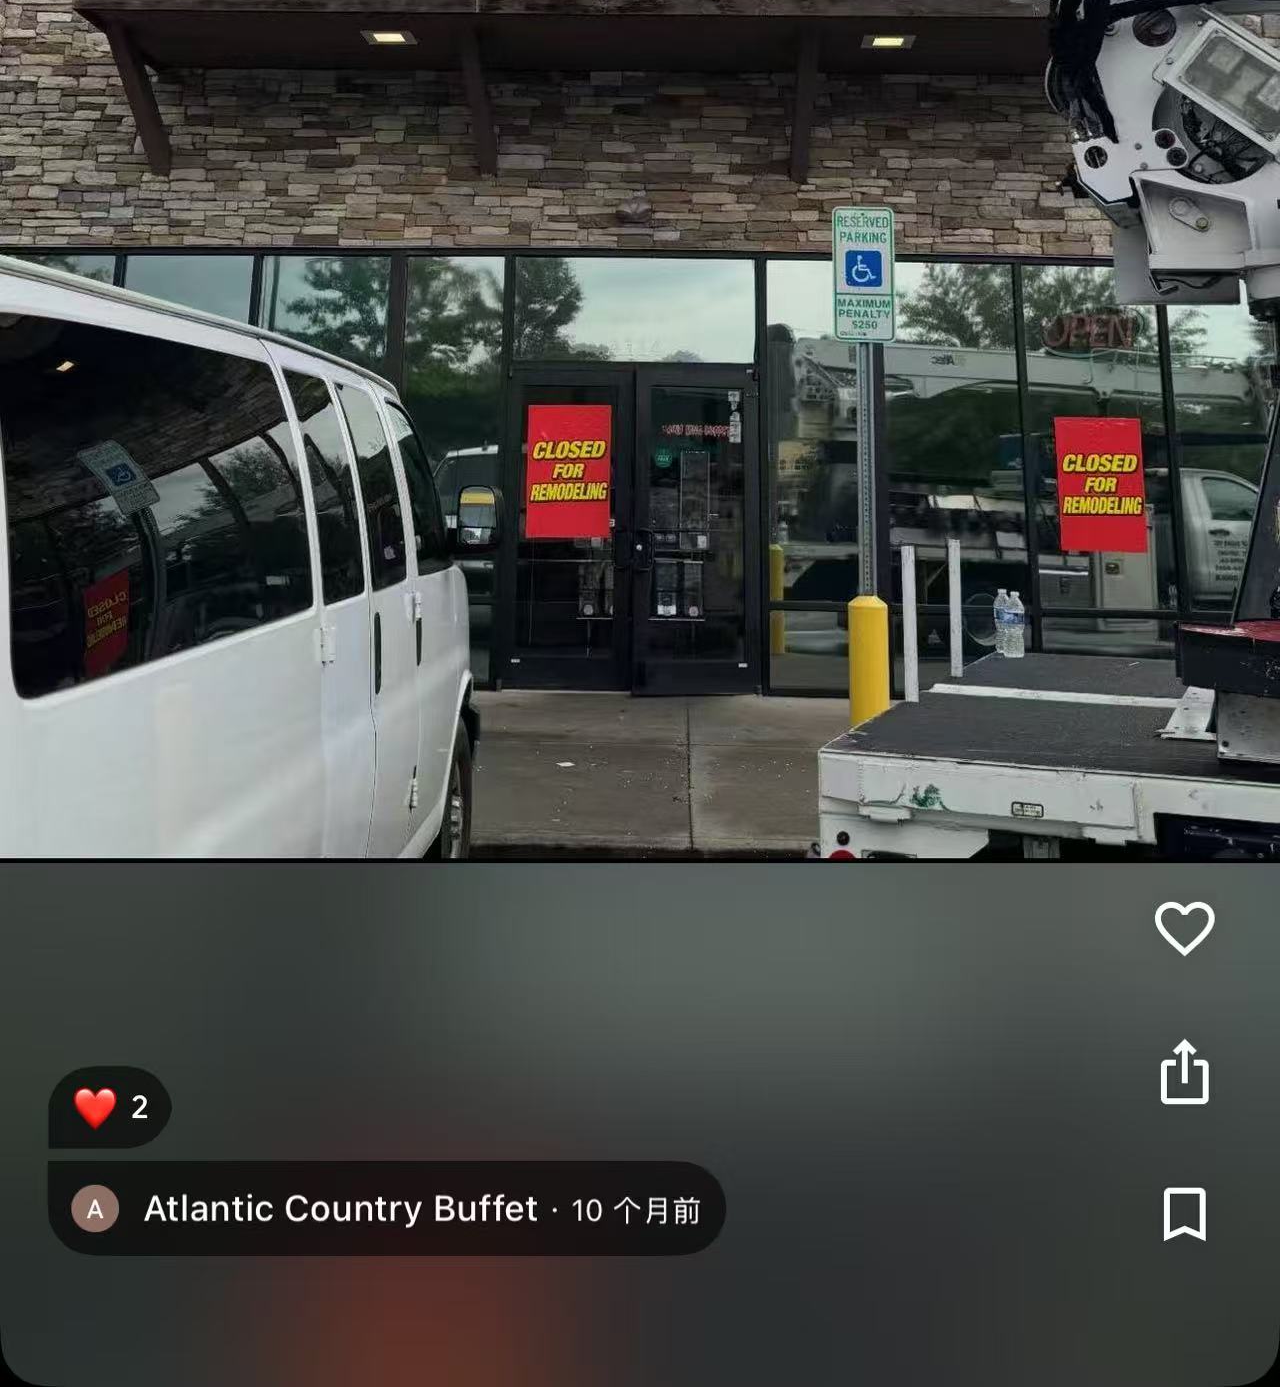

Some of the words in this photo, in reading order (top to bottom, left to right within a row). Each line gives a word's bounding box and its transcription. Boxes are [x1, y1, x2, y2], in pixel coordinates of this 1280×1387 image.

[837, 215, 889, 229] RESERVED
[839, 231, 887, 244] PARKING
[837, 298, 891, 309] MAXIMUM
[838, 308, 890, 318] PENALTY
[1042, 313, 1134, 349] OPEN
[532, 440, 607, 460] CLOSED
[552, 462, 586, 480] FOR
[1062, 453, 1138, 473] CLOSED
[530, 481, 608, 502] REMODELING
[1084, 476, 1119, 493] FOR
[1063, 496, 1143, 515] REMODELING
